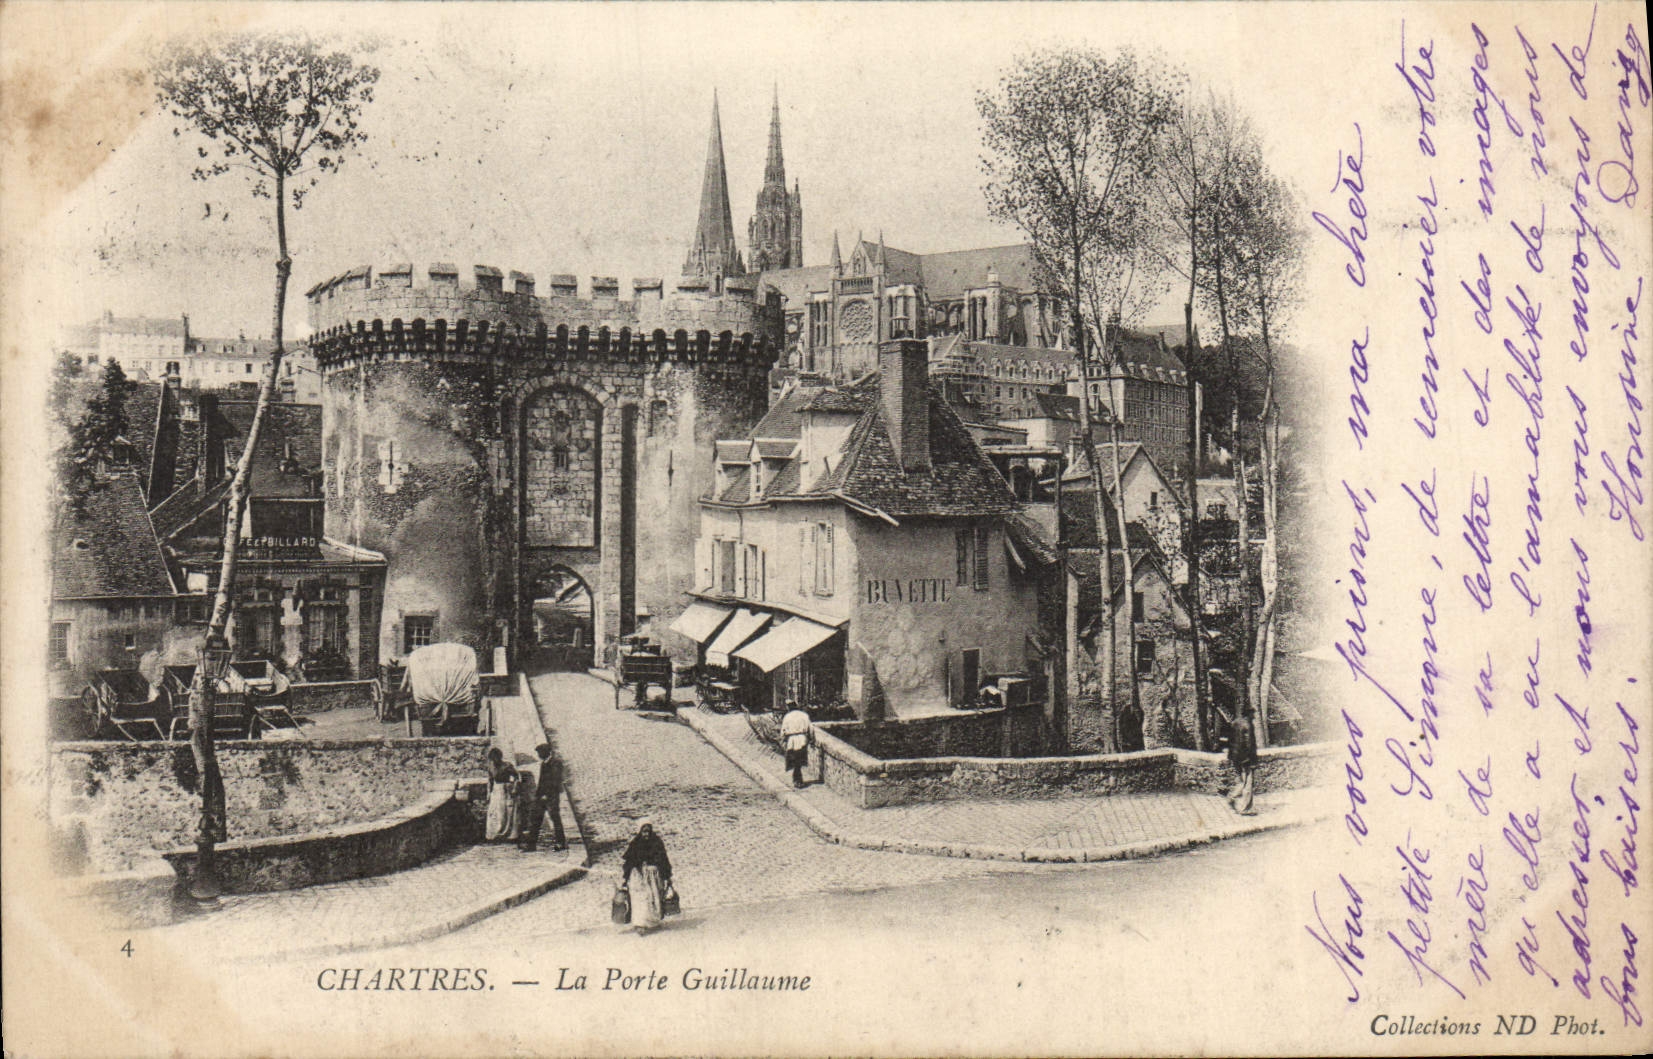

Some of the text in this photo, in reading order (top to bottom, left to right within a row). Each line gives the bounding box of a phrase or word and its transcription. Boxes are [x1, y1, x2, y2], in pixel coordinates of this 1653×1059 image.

[1395, 18, 1436, 156] votre
[1515, 24, 1548, 174] nous
[1551, 2, 1599, 99] de
[1312, 121, 1367, 286] chère
[1511, 202, 1545, 272] de
[1569, 115, 1621, 361] envoyons
[1348, 325, 1370, 450] ma
[1504, 283, 1544, 616] l'amabilité
[1566, 384, 1592, 515] vous
[267, 536, 316, 547] BILLARD
[1401, 467, 1440, 536] de
[1456, 21, 1524, 986] mère de sa lettre et des images
[867, 579, 951, 604] BUVETTE
[1570, 536, 1592, 678] nous
[1523, 636, 1540, 709] eu
[1554, 690, 1592, 754] et
[1341, 708, 1368, 845] vous
[1523, 738, 1541, 778] a
[1304, 873, 1364, 1002] Nous
[1387, 826, 1466, 998] petite
[1600, 921, 1642, 1026] bons
